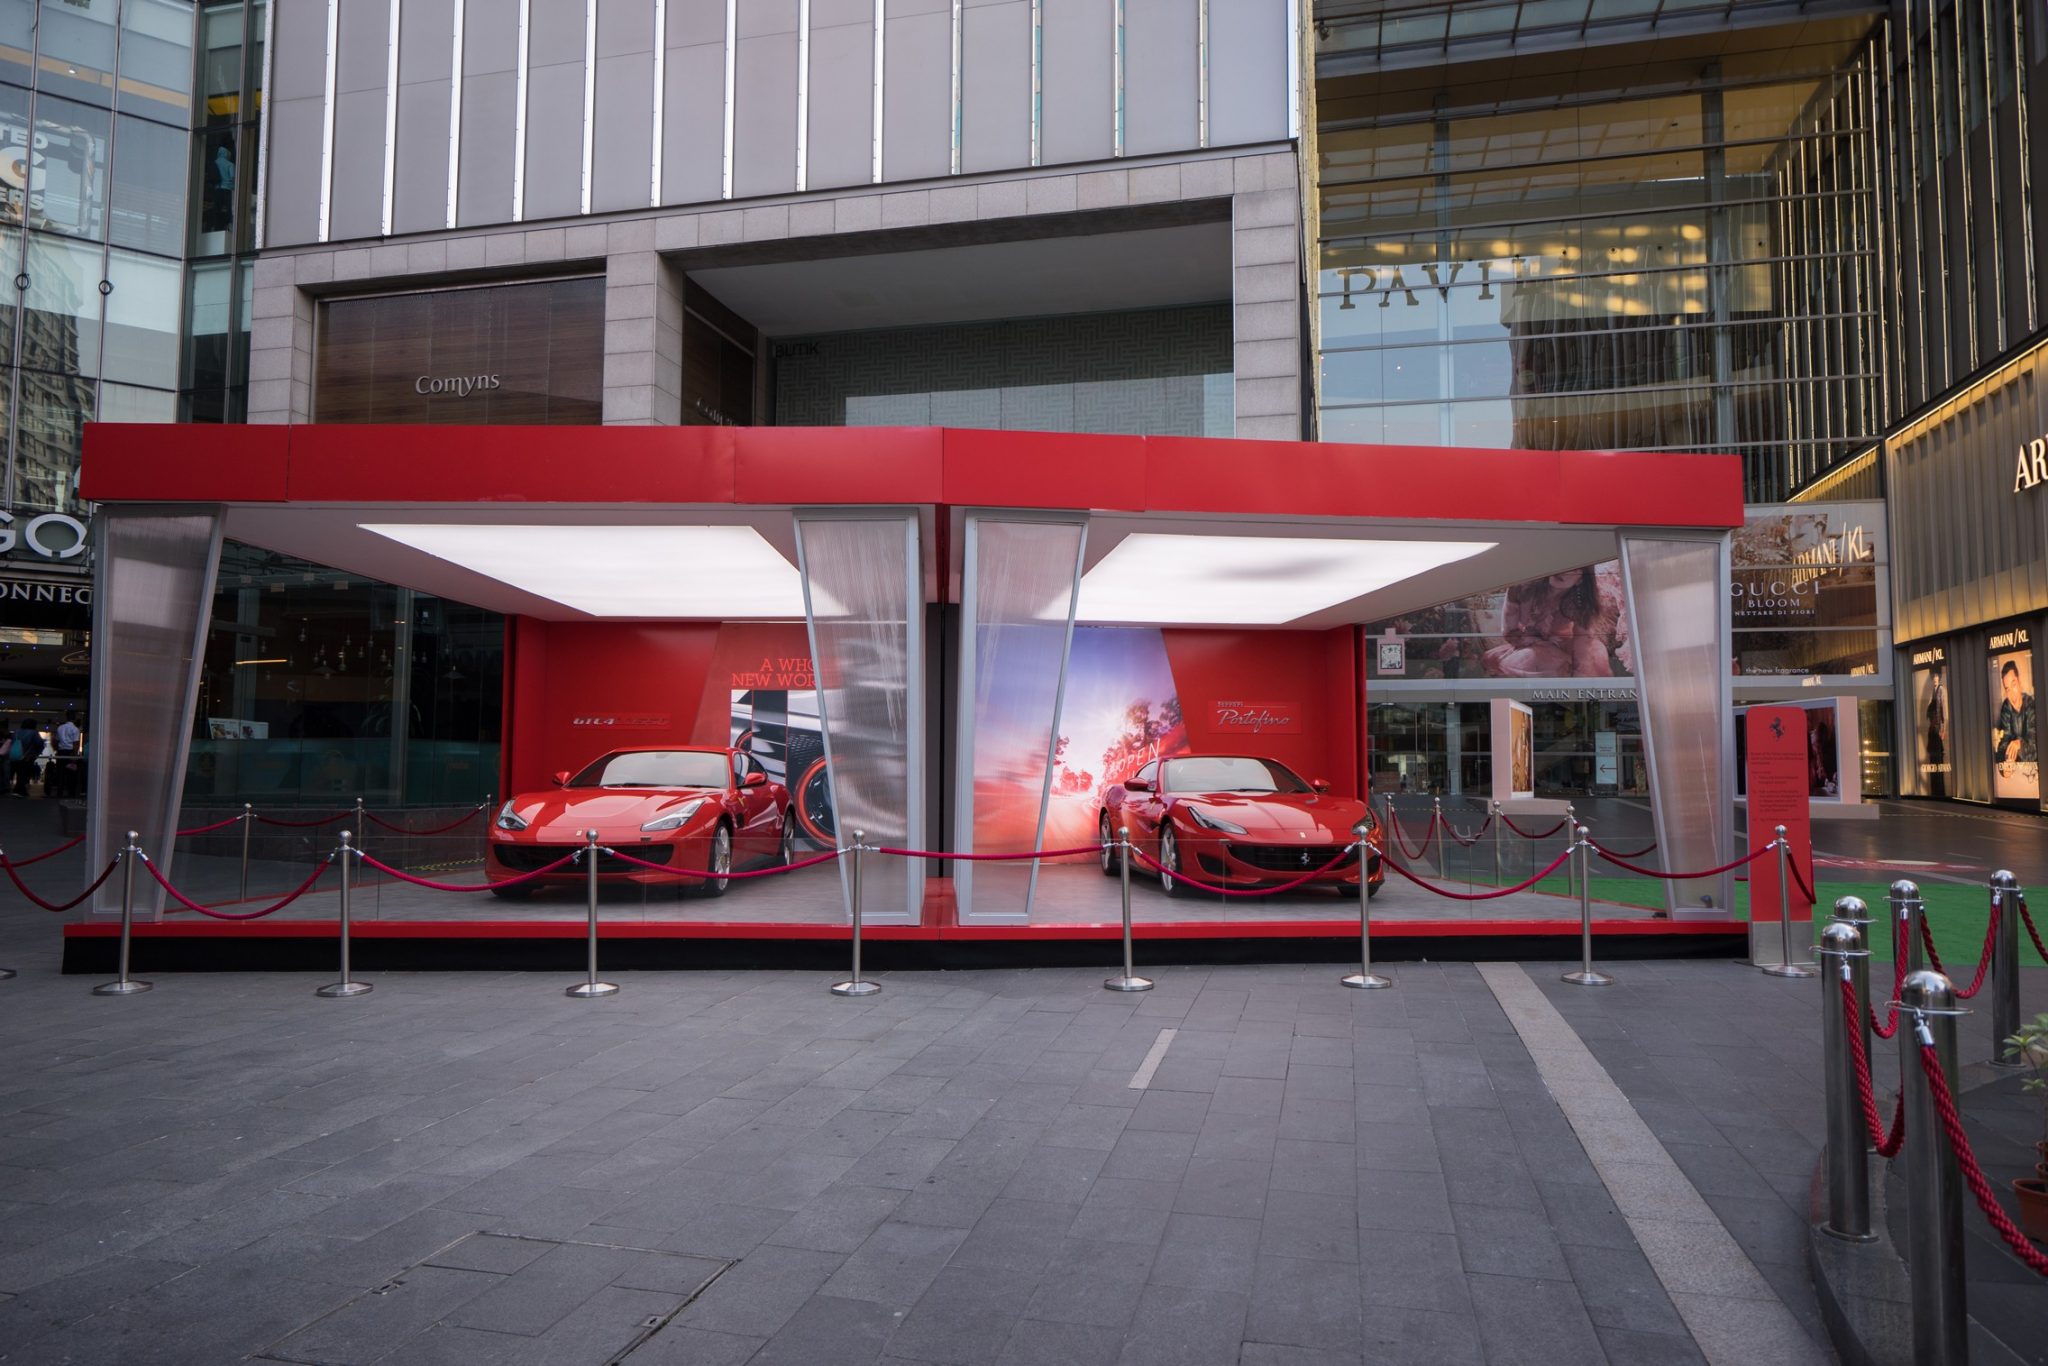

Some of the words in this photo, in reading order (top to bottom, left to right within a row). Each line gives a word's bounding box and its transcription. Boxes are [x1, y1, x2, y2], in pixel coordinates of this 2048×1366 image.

[415, 374, 500, 397] Comyns
[2013, 433, 2048, 493] AR
[1730, 580, 1820, 597] GUCCI
[1748, 598, 1801, 608] BLOOM
[1989, 628, 2029, 650] ARMANI/KL
[760, 658, 774, 672] A
[731, 673, 772, 687] NEW
[1532, 689, 1570, 700] MAIN
[1578, 688, 1638, 700] ENTRAN
[1216, 709, 1291, 734] Portofino
[1119, 738, 1161, 772] OPEN
